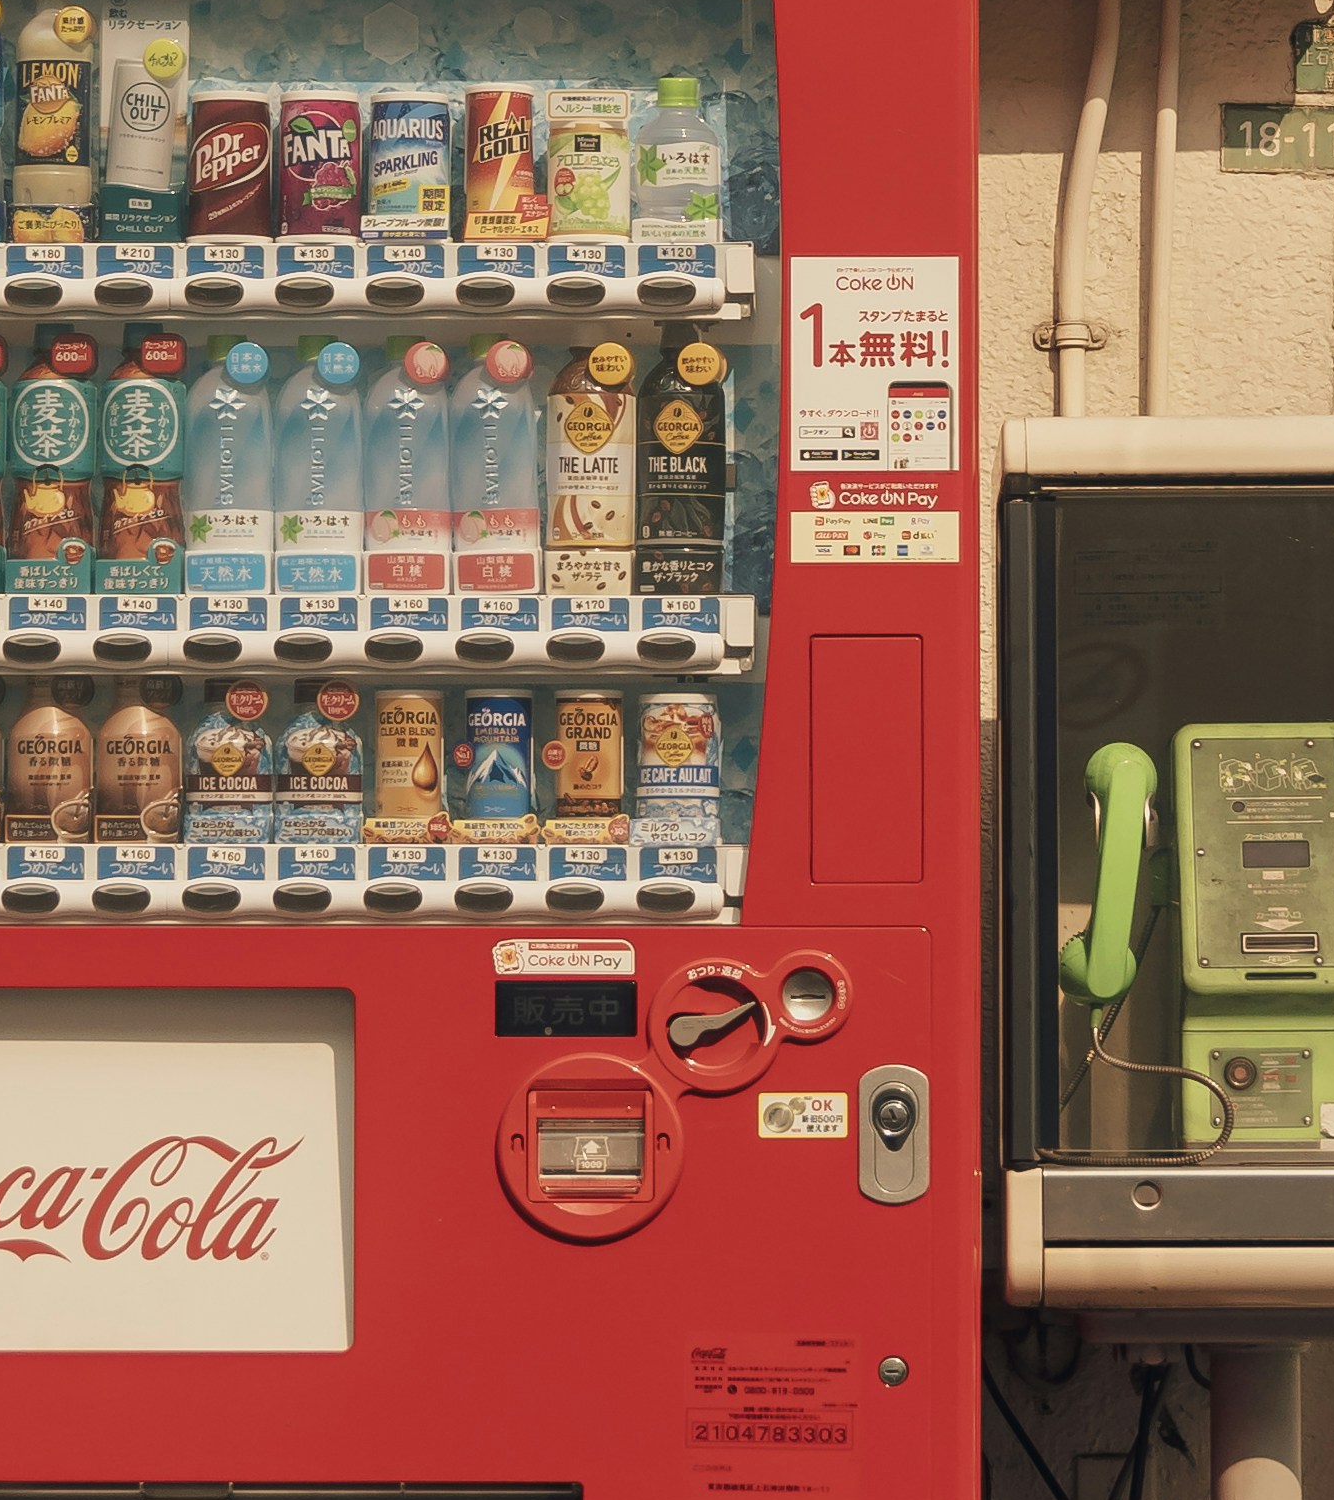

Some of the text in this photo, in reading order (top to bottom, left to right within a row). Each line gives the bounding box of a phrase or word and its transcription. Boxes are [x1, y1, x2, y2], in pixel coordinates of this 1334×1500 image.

[108, 19, 182, 31] リラクゼーション
[22, 63, 79, 86] LEMON
[125, 93, 166, 109] CHILL
[129, 108, 159, 122] OUT
[372, 118, 444, 141] AQUARIUS
[479, 112, 528, 143] REAL
[212, 132, 244, 158] Dr
[283, 129, 351, 167] FANTA
[479, 135, 529, 162] GOLD
[195, 143, 261, 185] Pepper
[373, 150, 438, 177] SPARKLING
[661, 152, 711, 165] いろはす
[121, 247, 151, 259] ¥210
[209, 249, 239, 259] ¥130
[484, 248, 513, 258] ¥130
[572, 249, 601, 259] ¥130
[661, 247, 692, 257] ¥120
[836, 274, 914, 291] Coke ON
[859, 310, 948, 323] スタンプたまると
[800, 303, 949, 367] 1本無料!
[32, 388, 66, 459] 麦茶
[121, 388, 156, 459] 麦茶
[559, 457, 619, 474] THE LATTE
[648, 457, 707, 473] THE BLACK
[839, 489, 938, 509] Coke ON Pay
[200, 566, 253, 582] 天然水
[290, 566, 343, 582] 天然水
[556, 561, 622, 572] まろやかな甘さ
[33, 598, 63, 609] ¥140
[122, 599, 152, 610] ¥140
[393, 598, 423, 609] ¥160
[483, 601, 513, 611] ¥160
[468, 707, 526, 726] GEORGIA
[559, 707, 618, 727] GEORGIA
[380, 727, 435, 737] CLEAR BLEND
[565, 727, 612, 739] GRAND
[199, 777, 257, 791] ICE COCOA
[290, 777, 348, 791] ICE COCOA
[527, 953, 622, 970] Coke ON Pay
[687, 966, 742, 980] おつり・返却
[513, 994, 618, 1026] 販売中
[812, 1100, 832, 1111] OK
[695, 1425, 847, 1444] 2104783303
